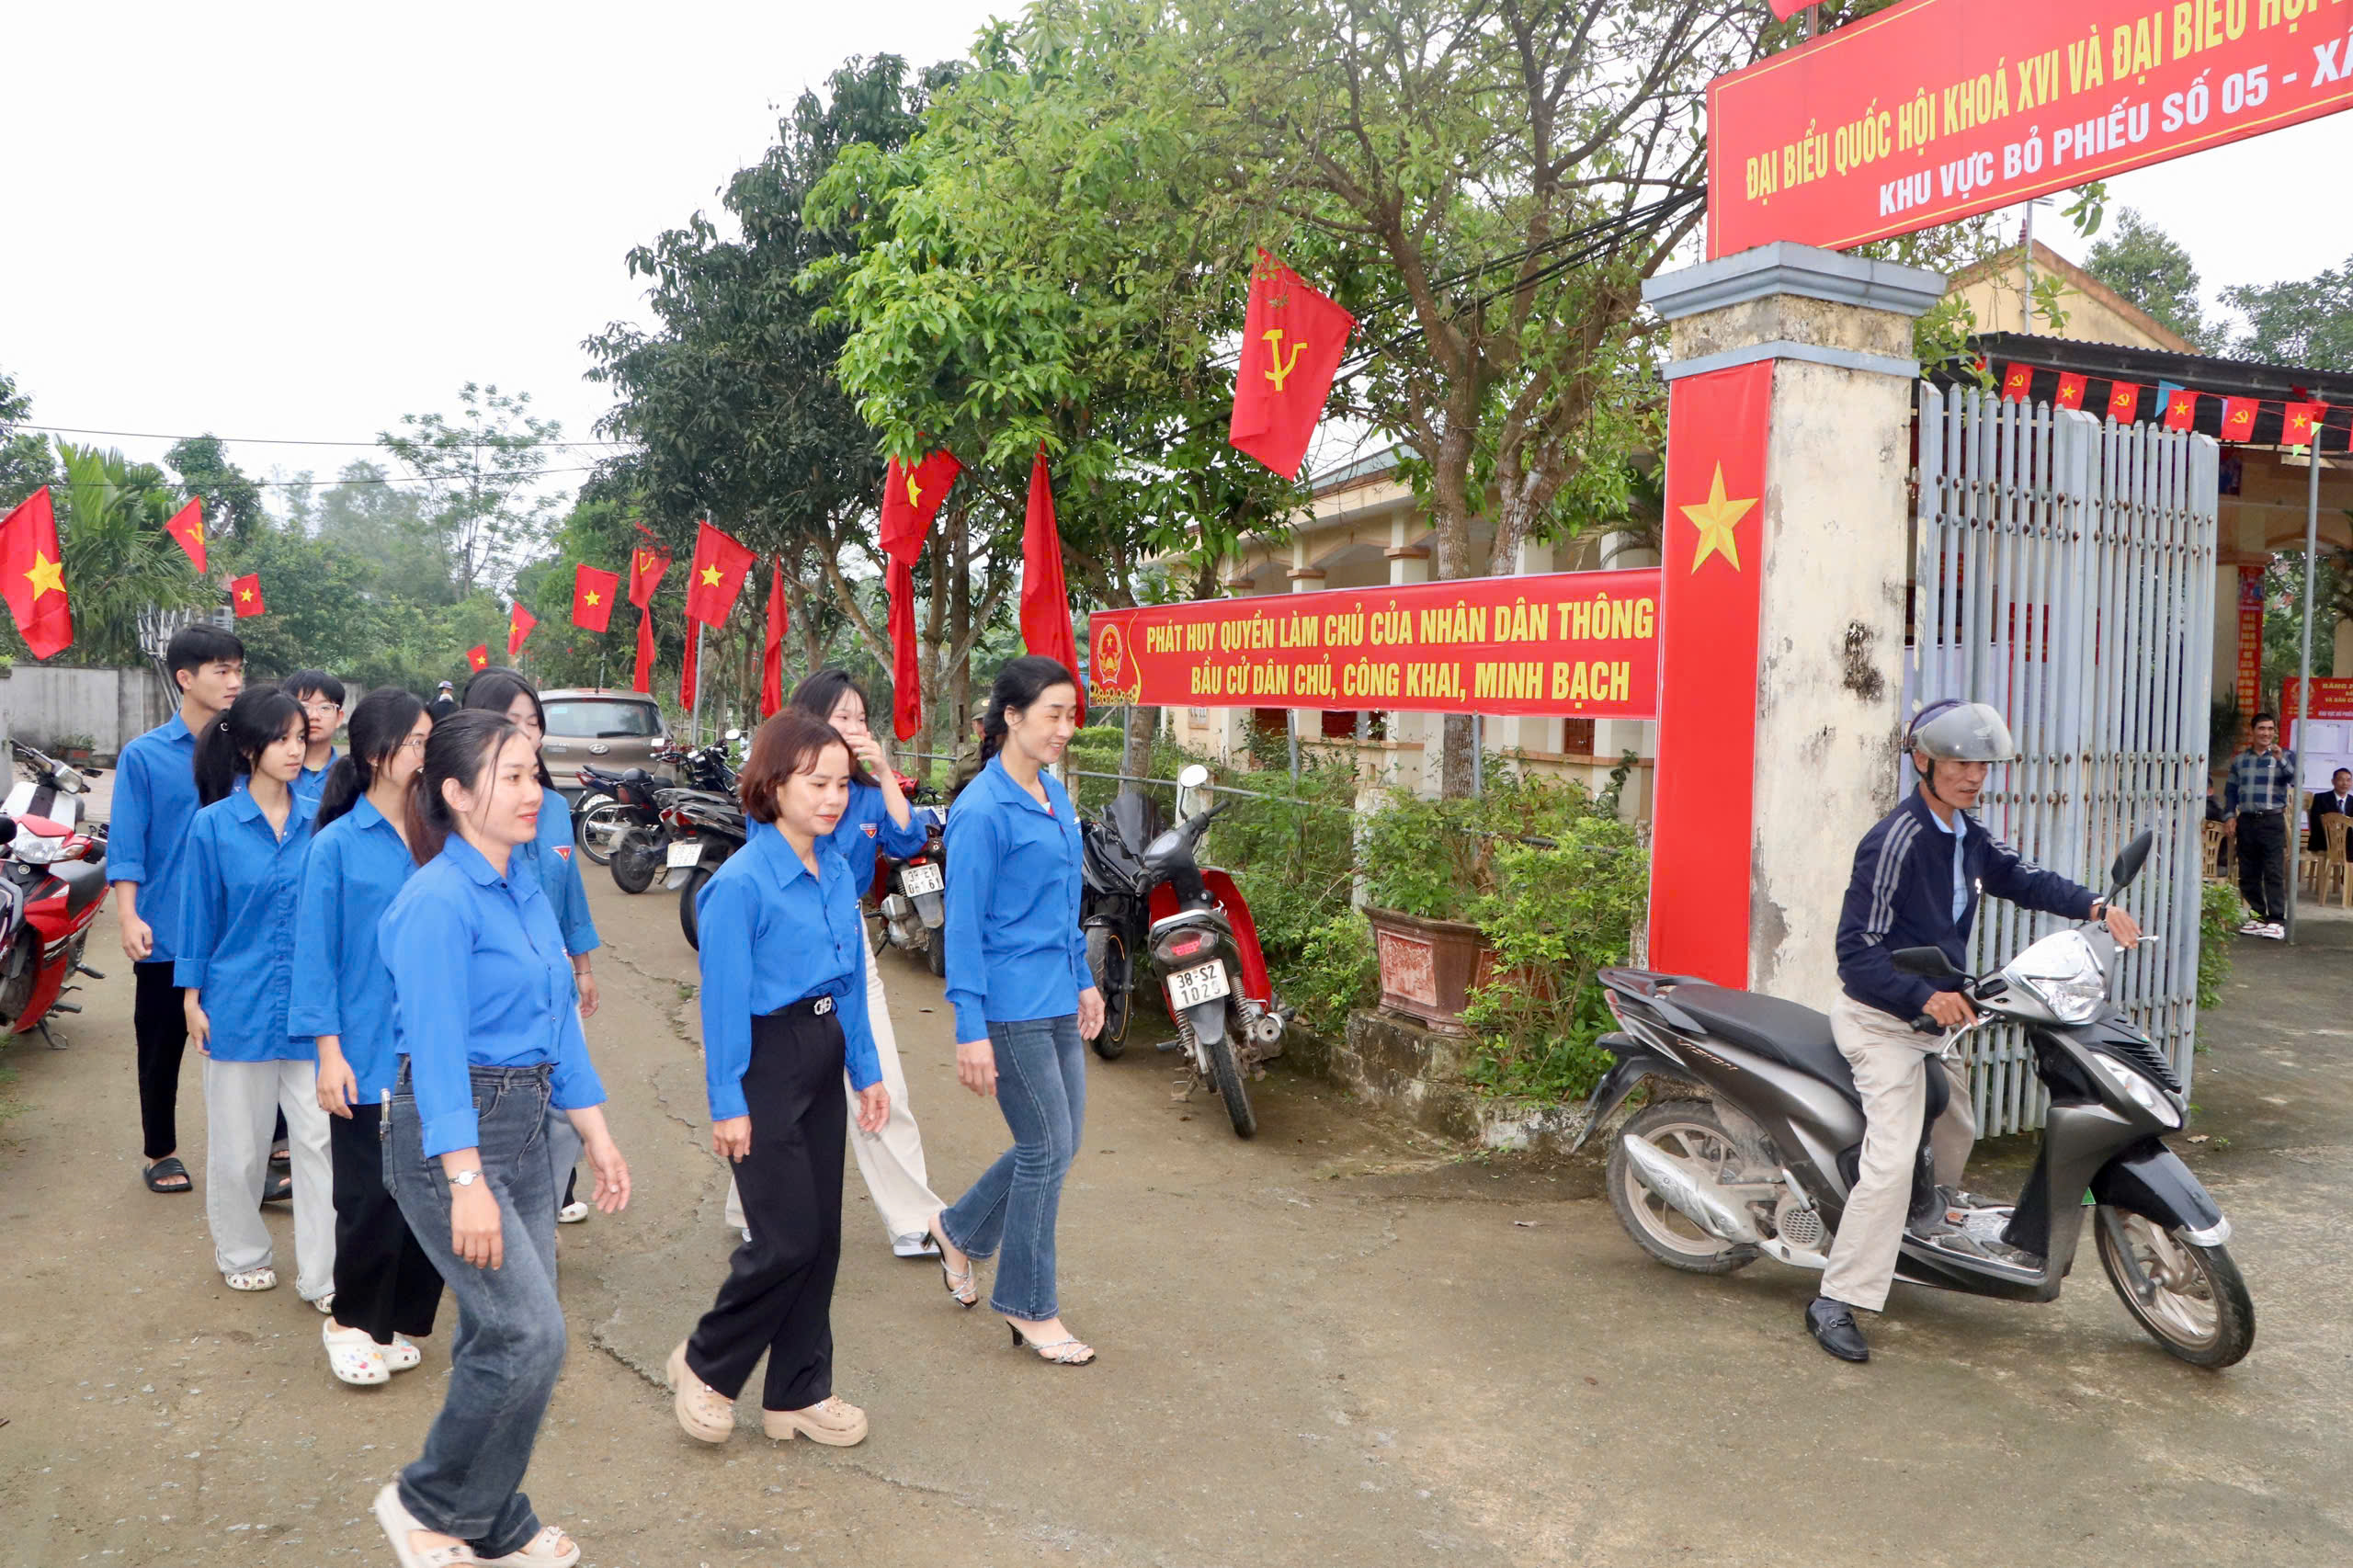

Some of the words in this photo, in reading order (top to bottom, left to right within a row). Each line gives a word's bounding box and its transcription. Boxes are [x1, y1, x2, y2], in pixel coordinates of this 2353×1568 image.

[1746, 149, 1779, 206] ĐẠI
[1784, 117, 1828, 189] BIỂU
[1836, 97, 1891, 176] QUỐC
[1898, 86, 1937, 156] HỘI
[1943, 56, 2010, 137] KHOÁ
[2017, 49, 2060, 113] XVI
[2068, 23, 2104, 95] VÀ
[2111, 10, 2163, 85] ĐẠI
[1880, 169, 1932, 218] KHU
[1939, 151, 1994, 199] VỰC
[2003, 124, 2043, 180] BỎ
[2052, 96, 2150, 166] PHIẾU
[2161, 67, 2211, 133] SỐ
[2222, 63, 2268, 114] 05
[1147, 619, 1183, 653] PHÁT
[1187, 622, 1216, 652] HUY
[1220, 608, 1275, 653] QUYỀN
[1279, 610, 1319, 649] LÀM
[1324, 602, 1364, 647] CHỦ
[1370, 599, 1413, 646] CỦA
[1420, 600, 1486, 643] NHÂN
[1494, 597, 1549, 642] DÂN
[1557, 592, 1654, 641] THÔNG
[1190, 656, 1222, 695] BẦU
[1226, 655, 1251, 695] CỬ
[1253, 658, 1289, 695] DÂN
[1293, 653, 1336, 699] CHỦ,
[1343, 656, 1400, 697] CÔNG
[1405, 663, 1466, 702] KHAI,
[1474, 662, 1544, 699] MINH
[1552, 662, 1631, 709] BẠCH
[1176, 965, 1218, 989] 38-S2
